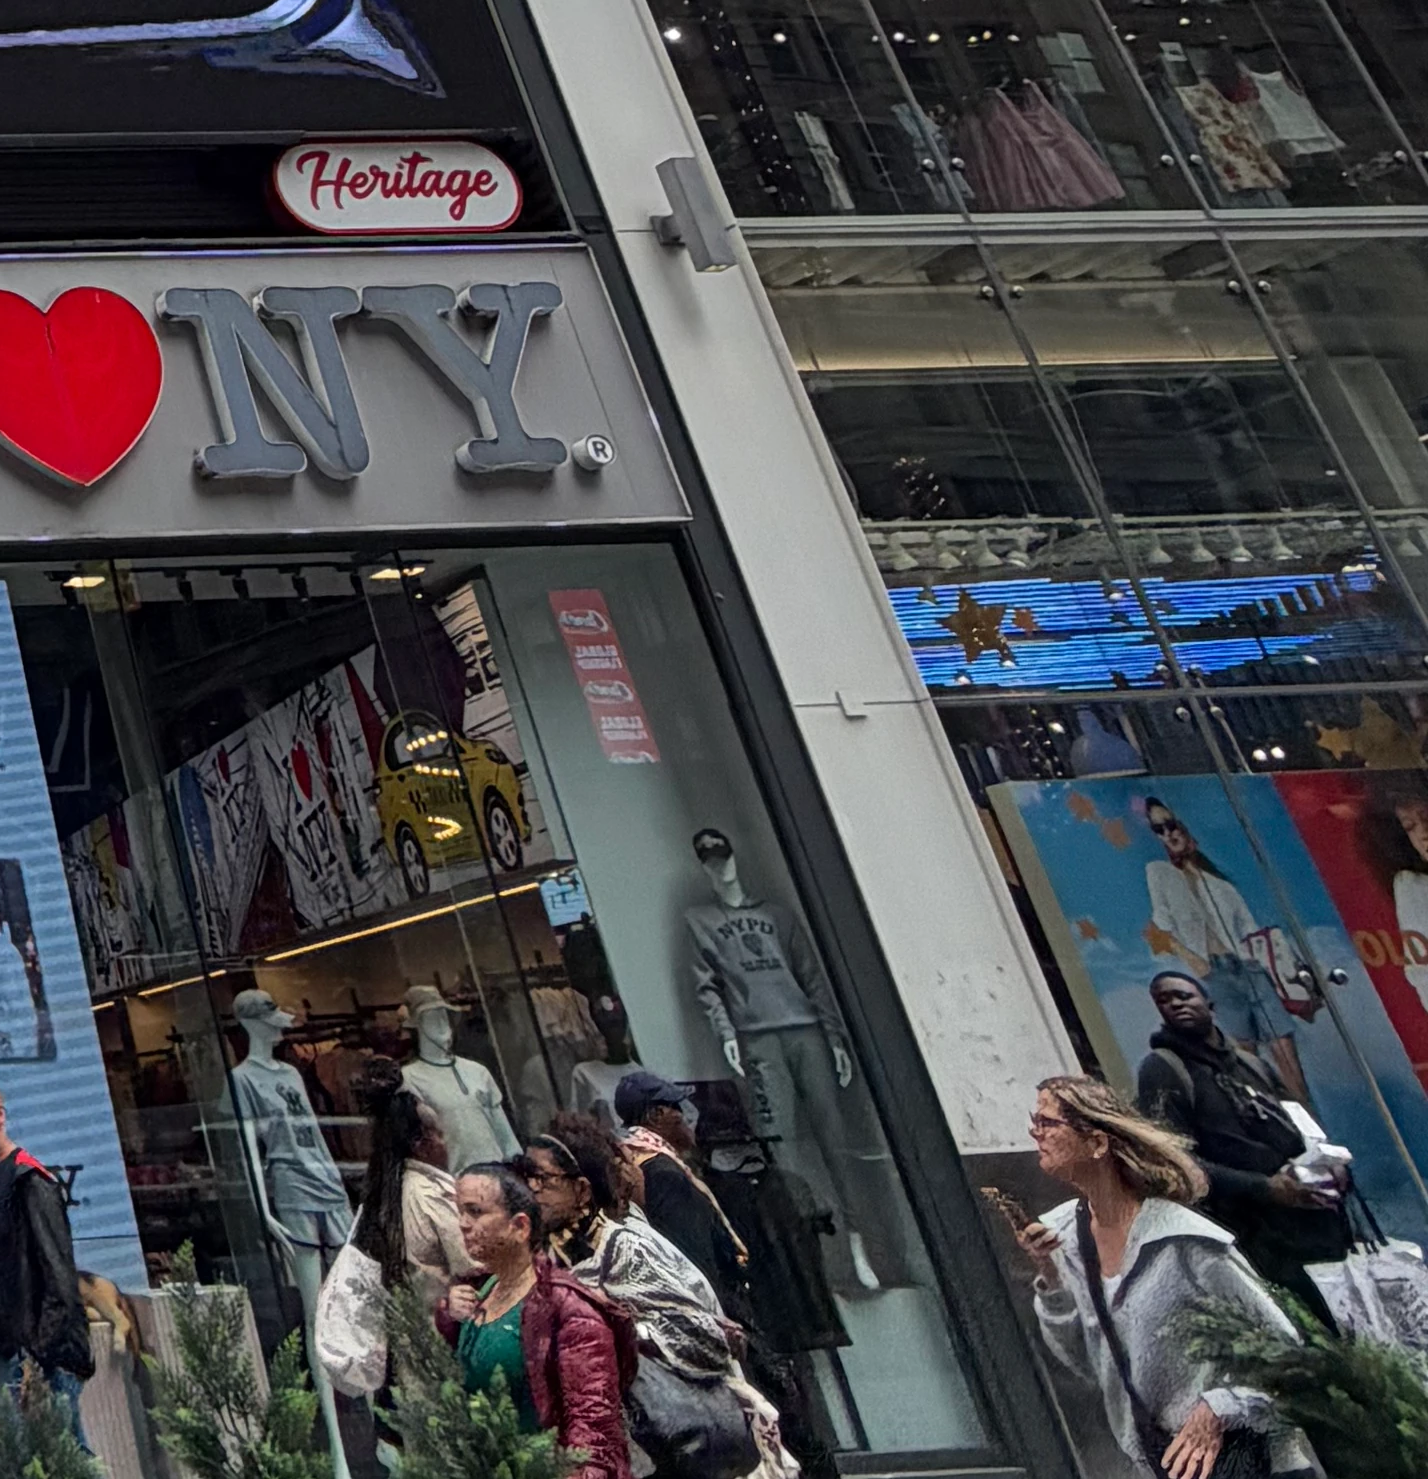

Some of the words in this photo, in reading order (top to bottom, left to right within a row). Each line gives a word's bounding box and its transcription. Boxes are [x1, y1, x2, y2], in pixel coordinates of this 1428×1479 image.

[295, 149, 499, 223] Heritage
[153, 280, 570, 481] NY
[717, 917, 775, 940] NYPD
